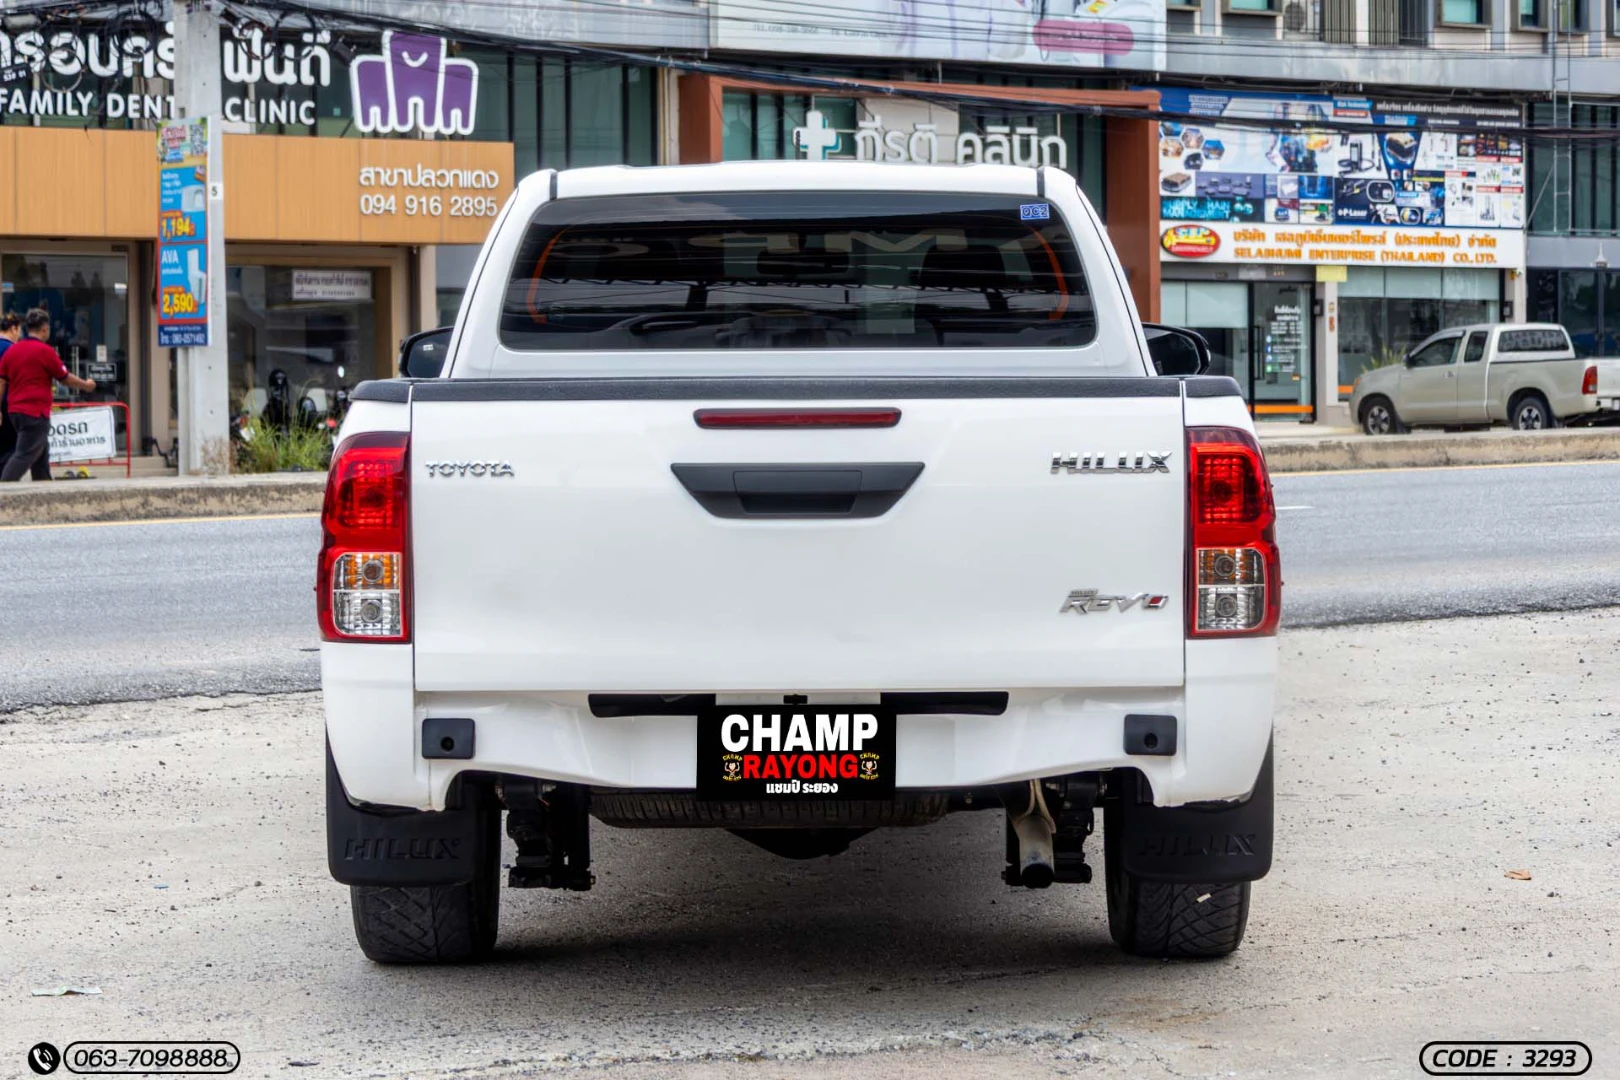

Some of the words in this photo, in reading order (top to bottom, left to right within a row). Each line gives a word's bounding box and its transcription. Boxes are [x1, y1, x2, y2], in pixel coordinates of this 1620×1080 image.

[0, 87, 94, 117] FAMILY
[106, 92, 174, 119] DENT
[225, 96, 316, 126] CLINIC
[956, 125, 1067, 168] คลินิก
[359, 162, 499, 189] สาขาปลวกแดง
[360, 193, 397, 215] 094
[405, 195, 443, 216] 916
[450, 195, 498, 217] 2895
[1309, 248, 1375, 261] ENTERPRISE
[1381, 251, 1445, 264] (THAILAND)
[163, 292, 194, 317] 2,590
[425, 459, 515, 478] TOYOTA
[1050, 451, 1173, 475] HILUX
[343, 838, 460, 860] HILUX
